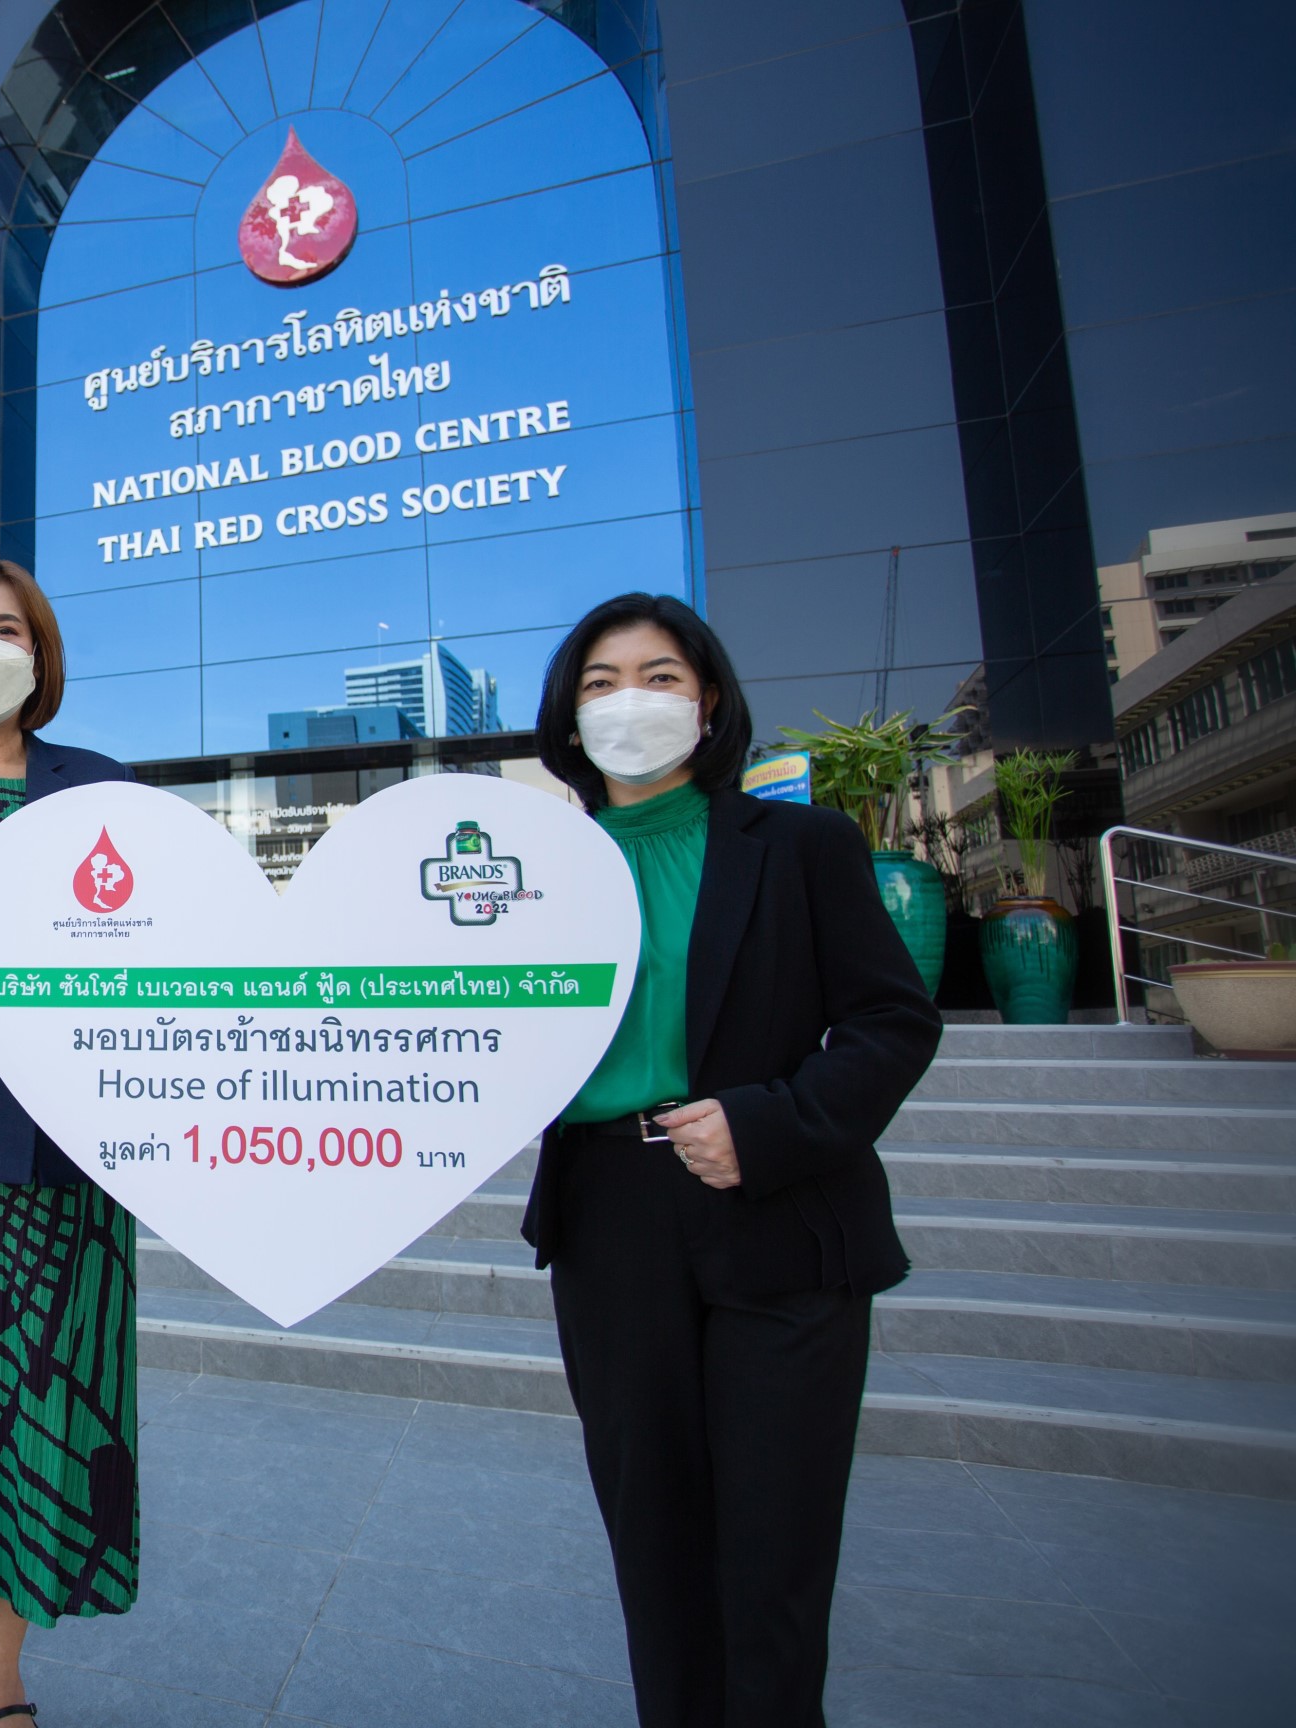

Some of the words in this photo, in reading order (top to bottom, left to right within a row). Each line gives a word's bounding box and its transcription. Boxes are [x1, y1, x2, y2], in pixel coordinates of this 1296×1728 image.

[84, 264, 571, 411] ศูนย์บริการโลหิตแห่งชาติ
[169, 352, 451, 439] สภากาชาดไทย
[92, 454, 268, 508] NATIONAL
[281, 430, 402, 477] BLOOD
[415, 400, 571, 453] CENTRE
[98, 525, 182, 564] THAI
[194, 513, 263, 550] RED
[275, 493, 388, 537] CROSS
[401, 465, 568, 518] SOCIETY
[439, 864, 504, 881] BRAND'S
[456, 892, 499, 902] YOUNG
[503, 890, 543, 901] BLOOD
[475, 903, 509, 914] 2022
[52, 917, 153, 931] ศูนย์บริการโลหิตแห่งชาติ
[70, 928, 130, 938] สภากาชาดไทย
[59, 969, 129, 996] ซันโทรี่
[137, 980, 233, 996] เบเวอเรจ
[244, 971, 308, 996] แอนด์
[316, 973, 351, 1004] ฟู้ด
[360, 971, 510, 999] (ประเทศไทย)
[519, 971, 580, 995] จำกัด
[73, 1015, 502, 1053] มอบบัตรเข้าชมนิทรรศการ
[99, 1069, 206, 1100] House
[216, 1069, 253, 1101] of
[262, 1070, 479, 1103] illumination
[99, 1133, 171, 1170] มูลค่า
[183, 1125, 403, 1173] 1,050,000
[417, 1149, 467, 1168] บาท
